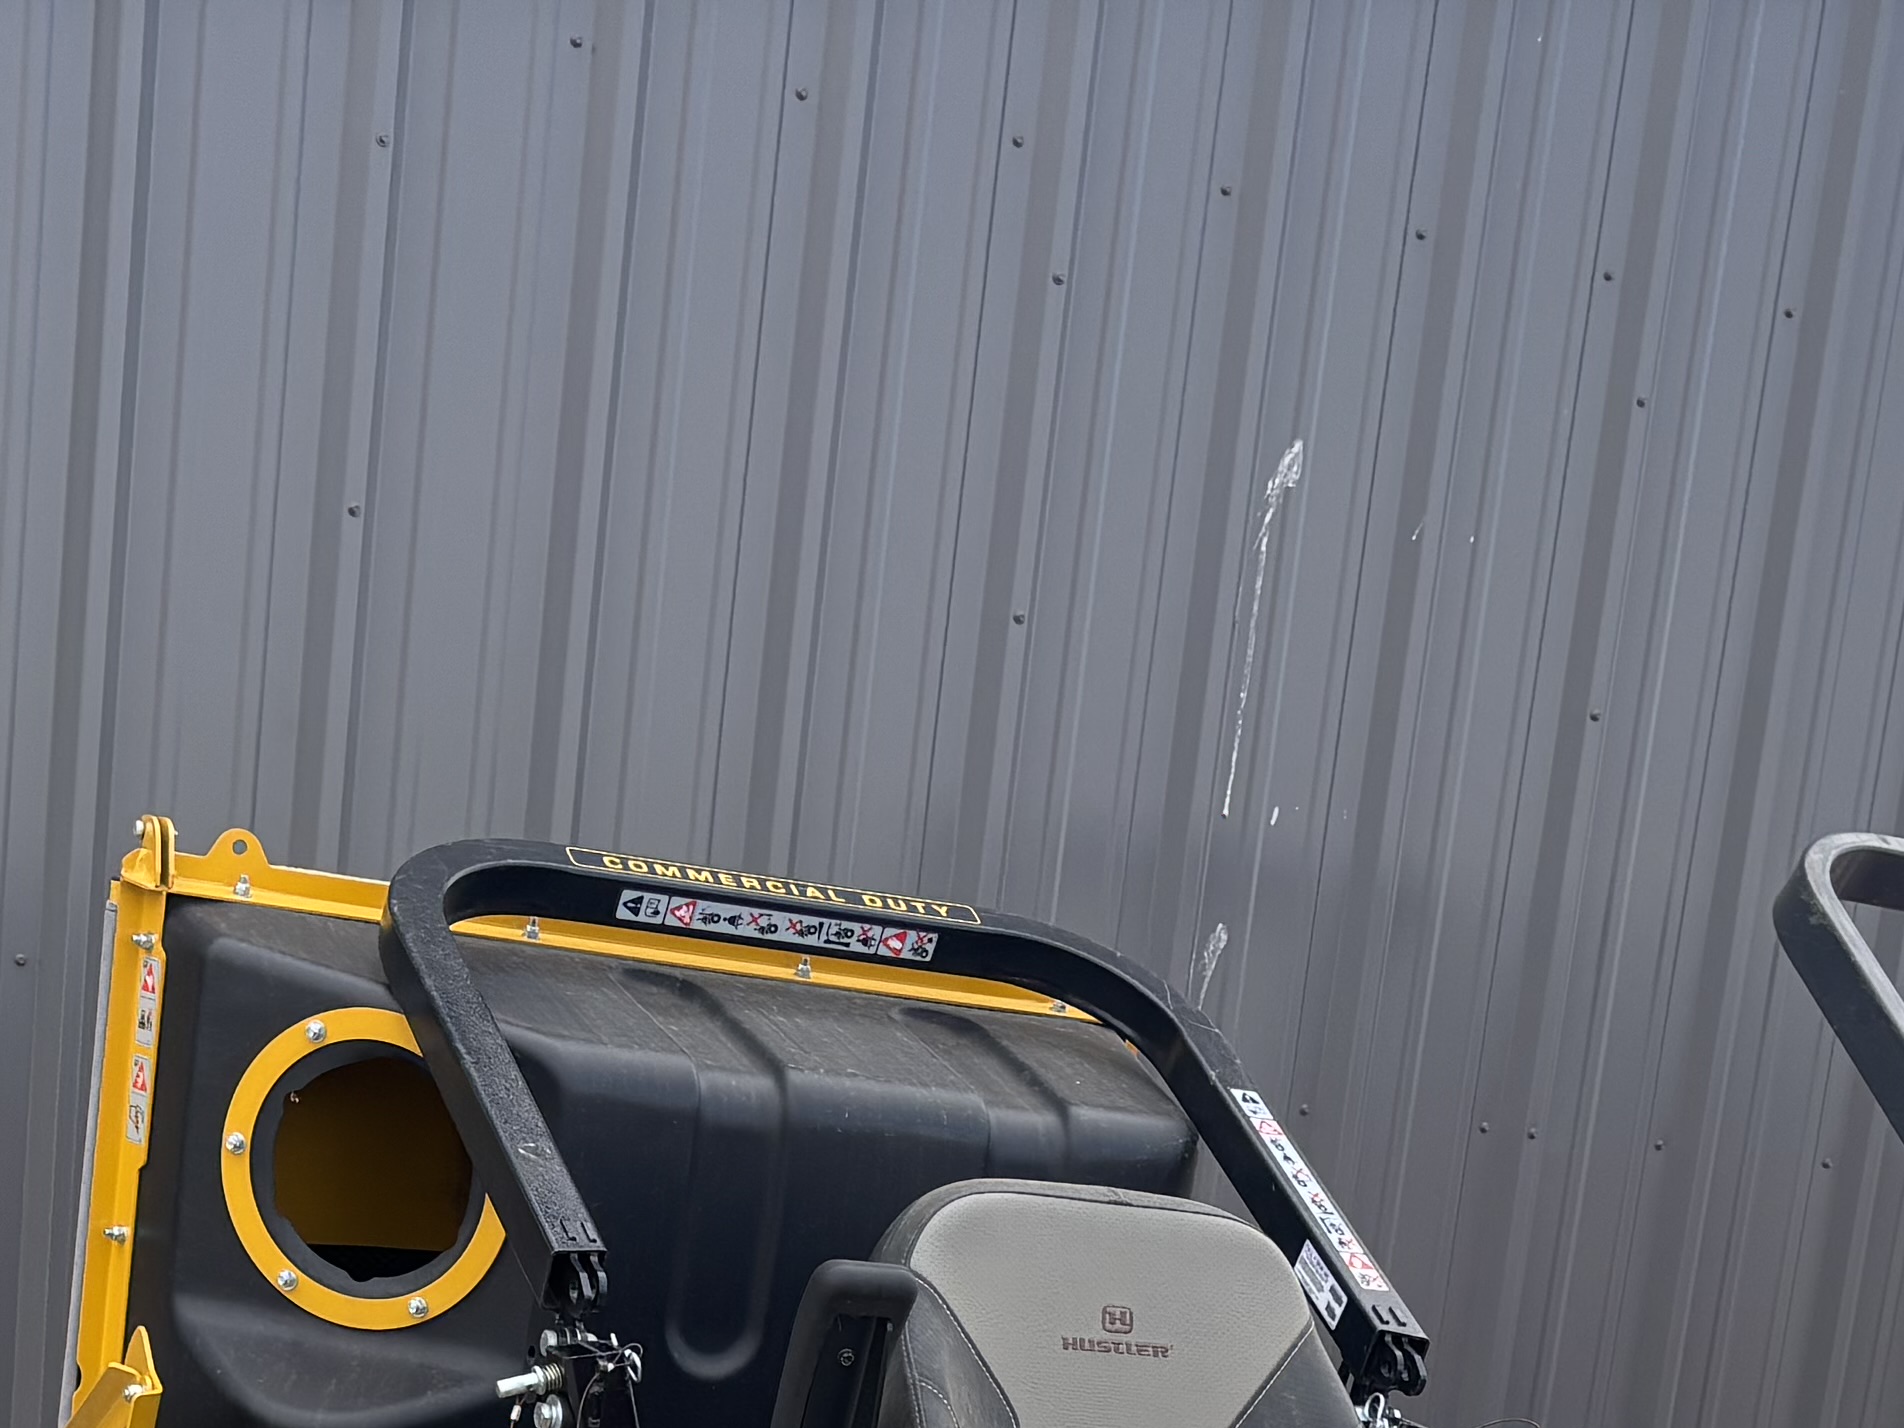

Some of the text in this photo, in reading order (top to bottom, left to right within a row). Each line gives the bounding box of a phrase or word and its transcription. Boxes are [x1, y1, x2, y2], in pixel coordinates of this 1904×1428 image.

[602, 856, 950, 918] COMMERCIAL DUTY
[1061, 1335, 1170, 1358] HUSTLER
